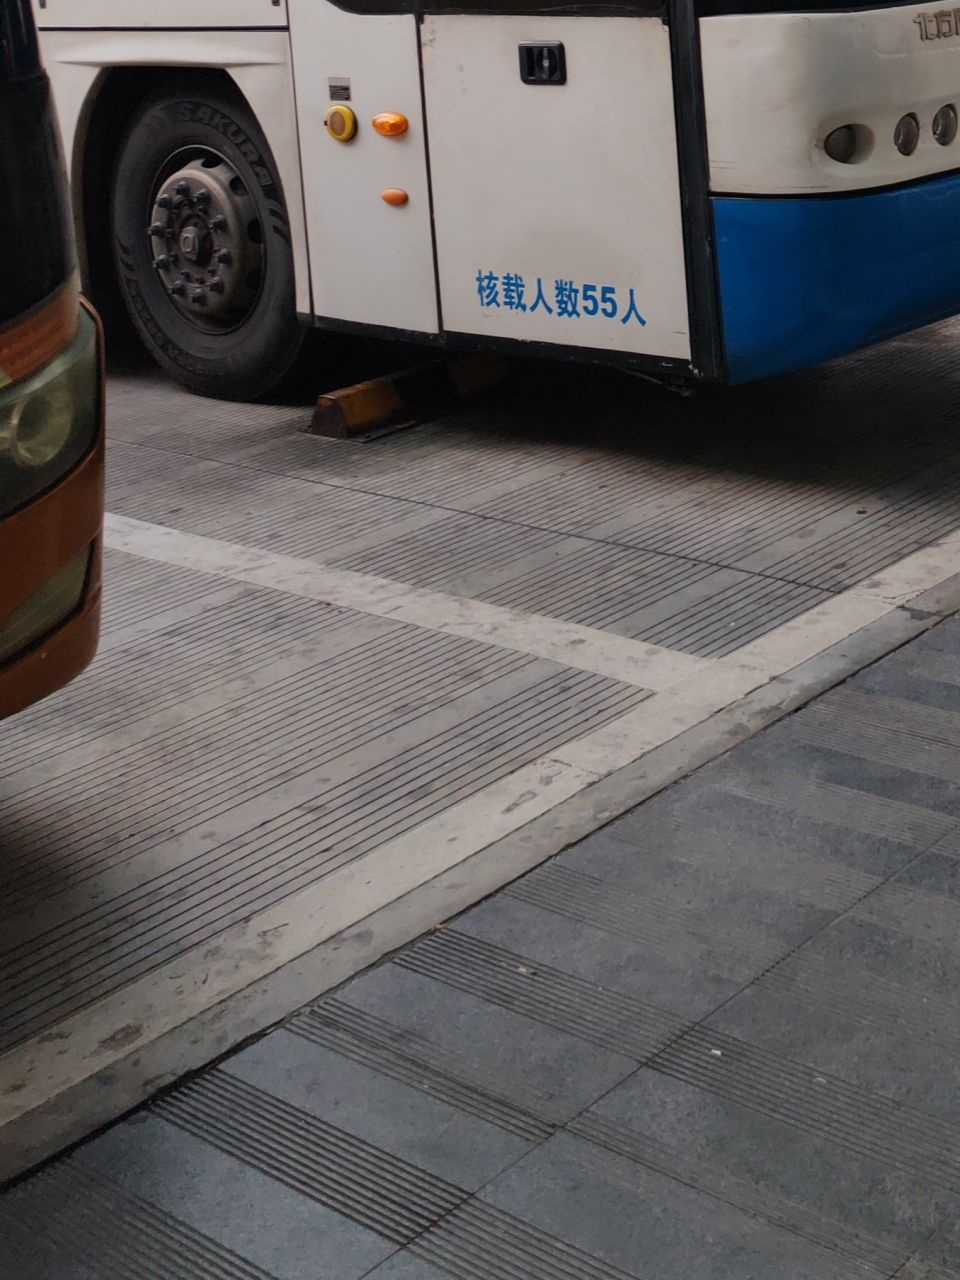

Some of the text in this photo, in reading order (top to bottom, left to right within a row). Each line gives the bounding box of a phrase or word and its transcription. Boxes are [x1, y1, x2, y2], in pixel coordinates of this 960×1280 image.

[475, 269, 647, 327] 核载人数55人
